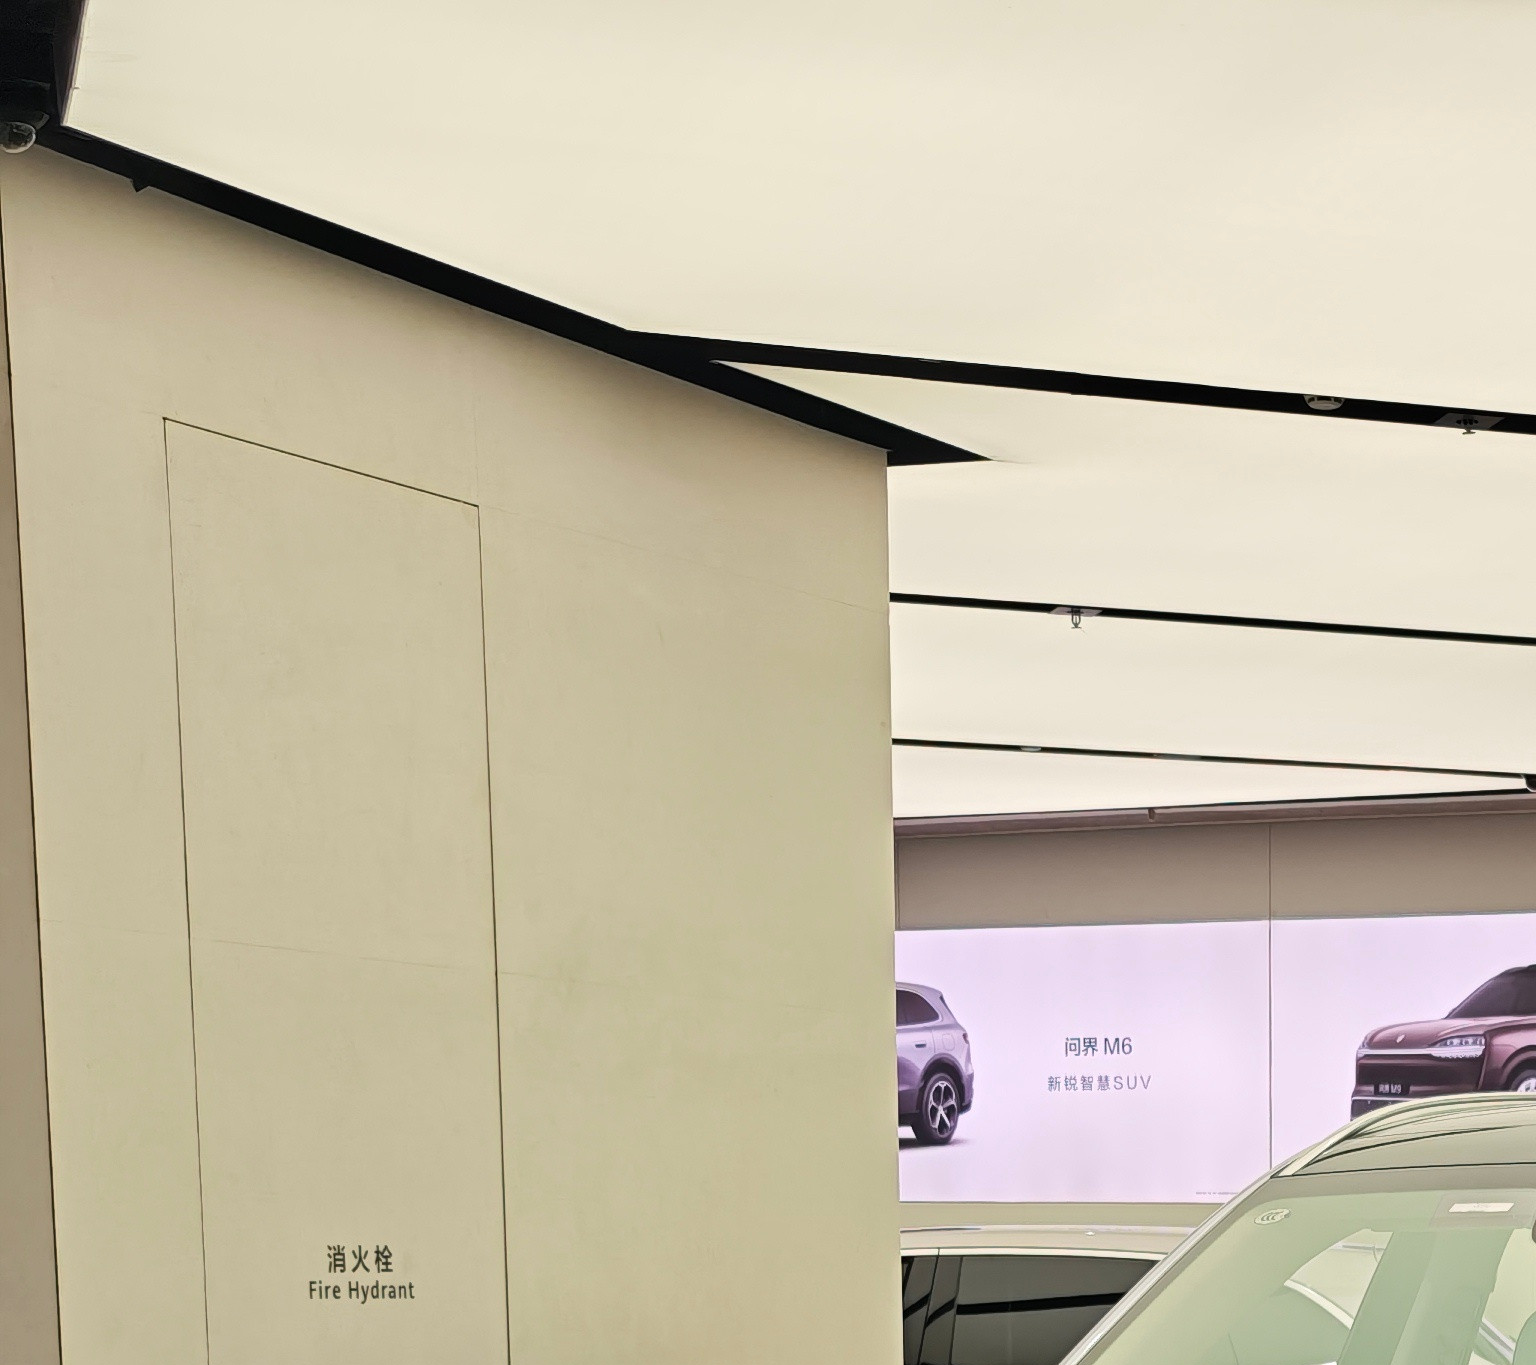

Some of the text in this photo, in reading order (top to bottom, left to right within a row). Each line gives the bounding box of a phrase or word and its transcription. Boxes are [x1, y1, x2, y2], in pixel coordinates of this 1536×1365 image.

[1064, 1036, 1133, 1057] 问界 M6
[326, 1244, 394, 1274] 消火栓
[308, 1280, 416, 1305] Fire Hydrant
